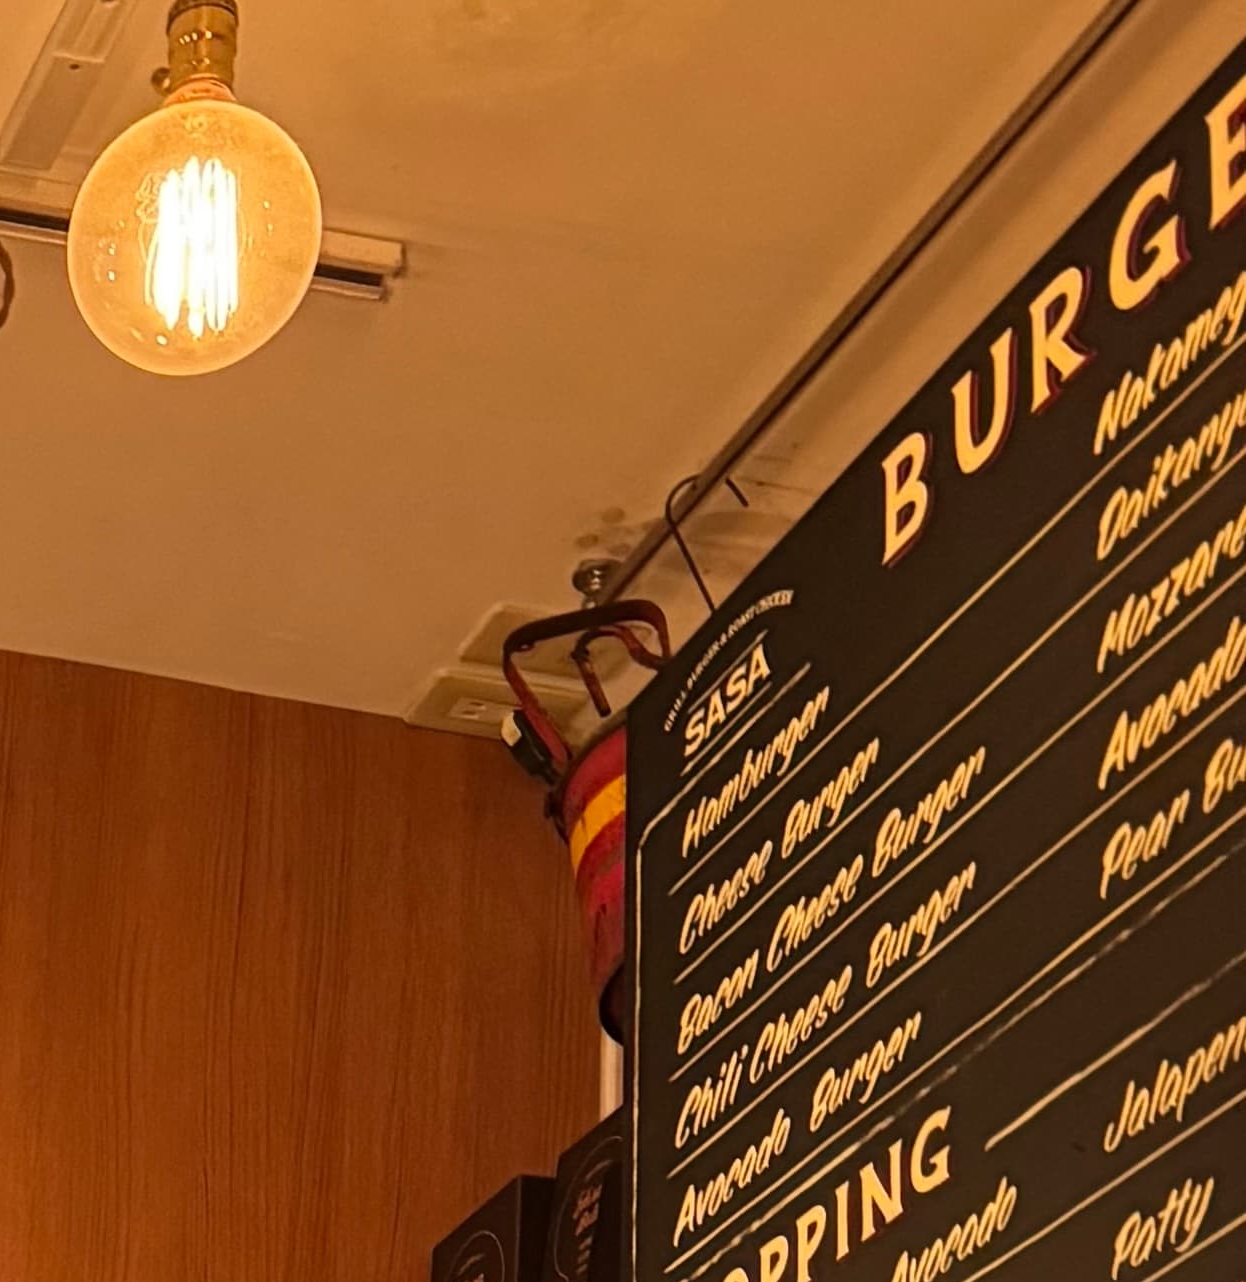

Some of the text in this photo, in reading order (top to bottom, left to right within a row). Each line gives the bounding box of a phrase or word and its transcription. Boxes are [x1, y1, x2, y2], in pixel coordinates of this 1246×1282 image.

[682, 686, 830, 858] Hamburger
[684, 644, 771, 757] SASA
[677, 746, 985, 1055] Bacon Cheese Burger
[679, 737, 880, 955] Cheese Burger
[1100, 788, 1190, 899] Pear
[675, 861, 976, 1149] Chili Cheese Burger
[673, 1011, 922, 1248] Avocado Burger
[1111, 1176, 1215, 1281] Patty
